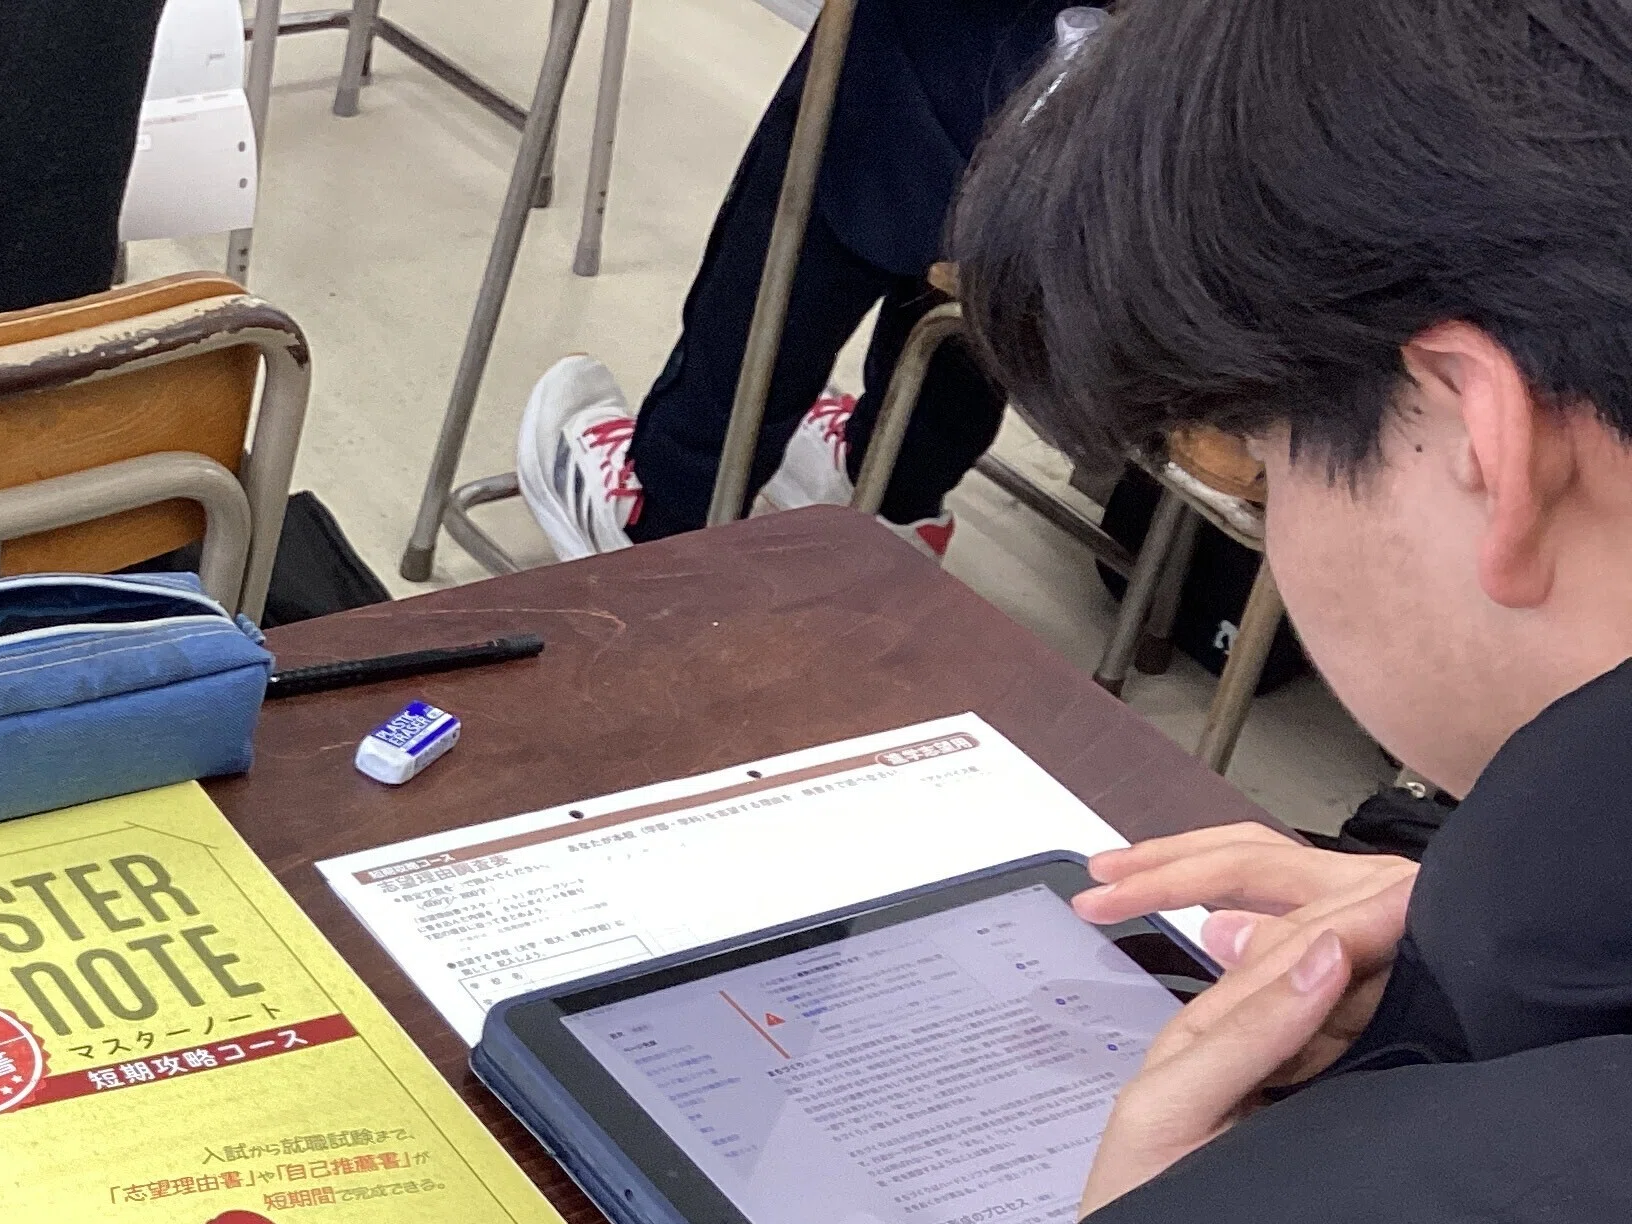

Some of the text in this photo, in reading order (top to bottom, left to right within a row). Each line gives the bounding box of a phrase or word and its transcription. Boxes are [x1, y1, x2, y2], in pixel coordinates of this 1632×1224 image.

[10, 924, 266, 1036] NOTE
[68, 1002, 281, 1059] マスターノート
[87, 1029, 309, 1090] 短期攻略コース
[201, 1127, 416, 1165] 入試から就職試験まで、
